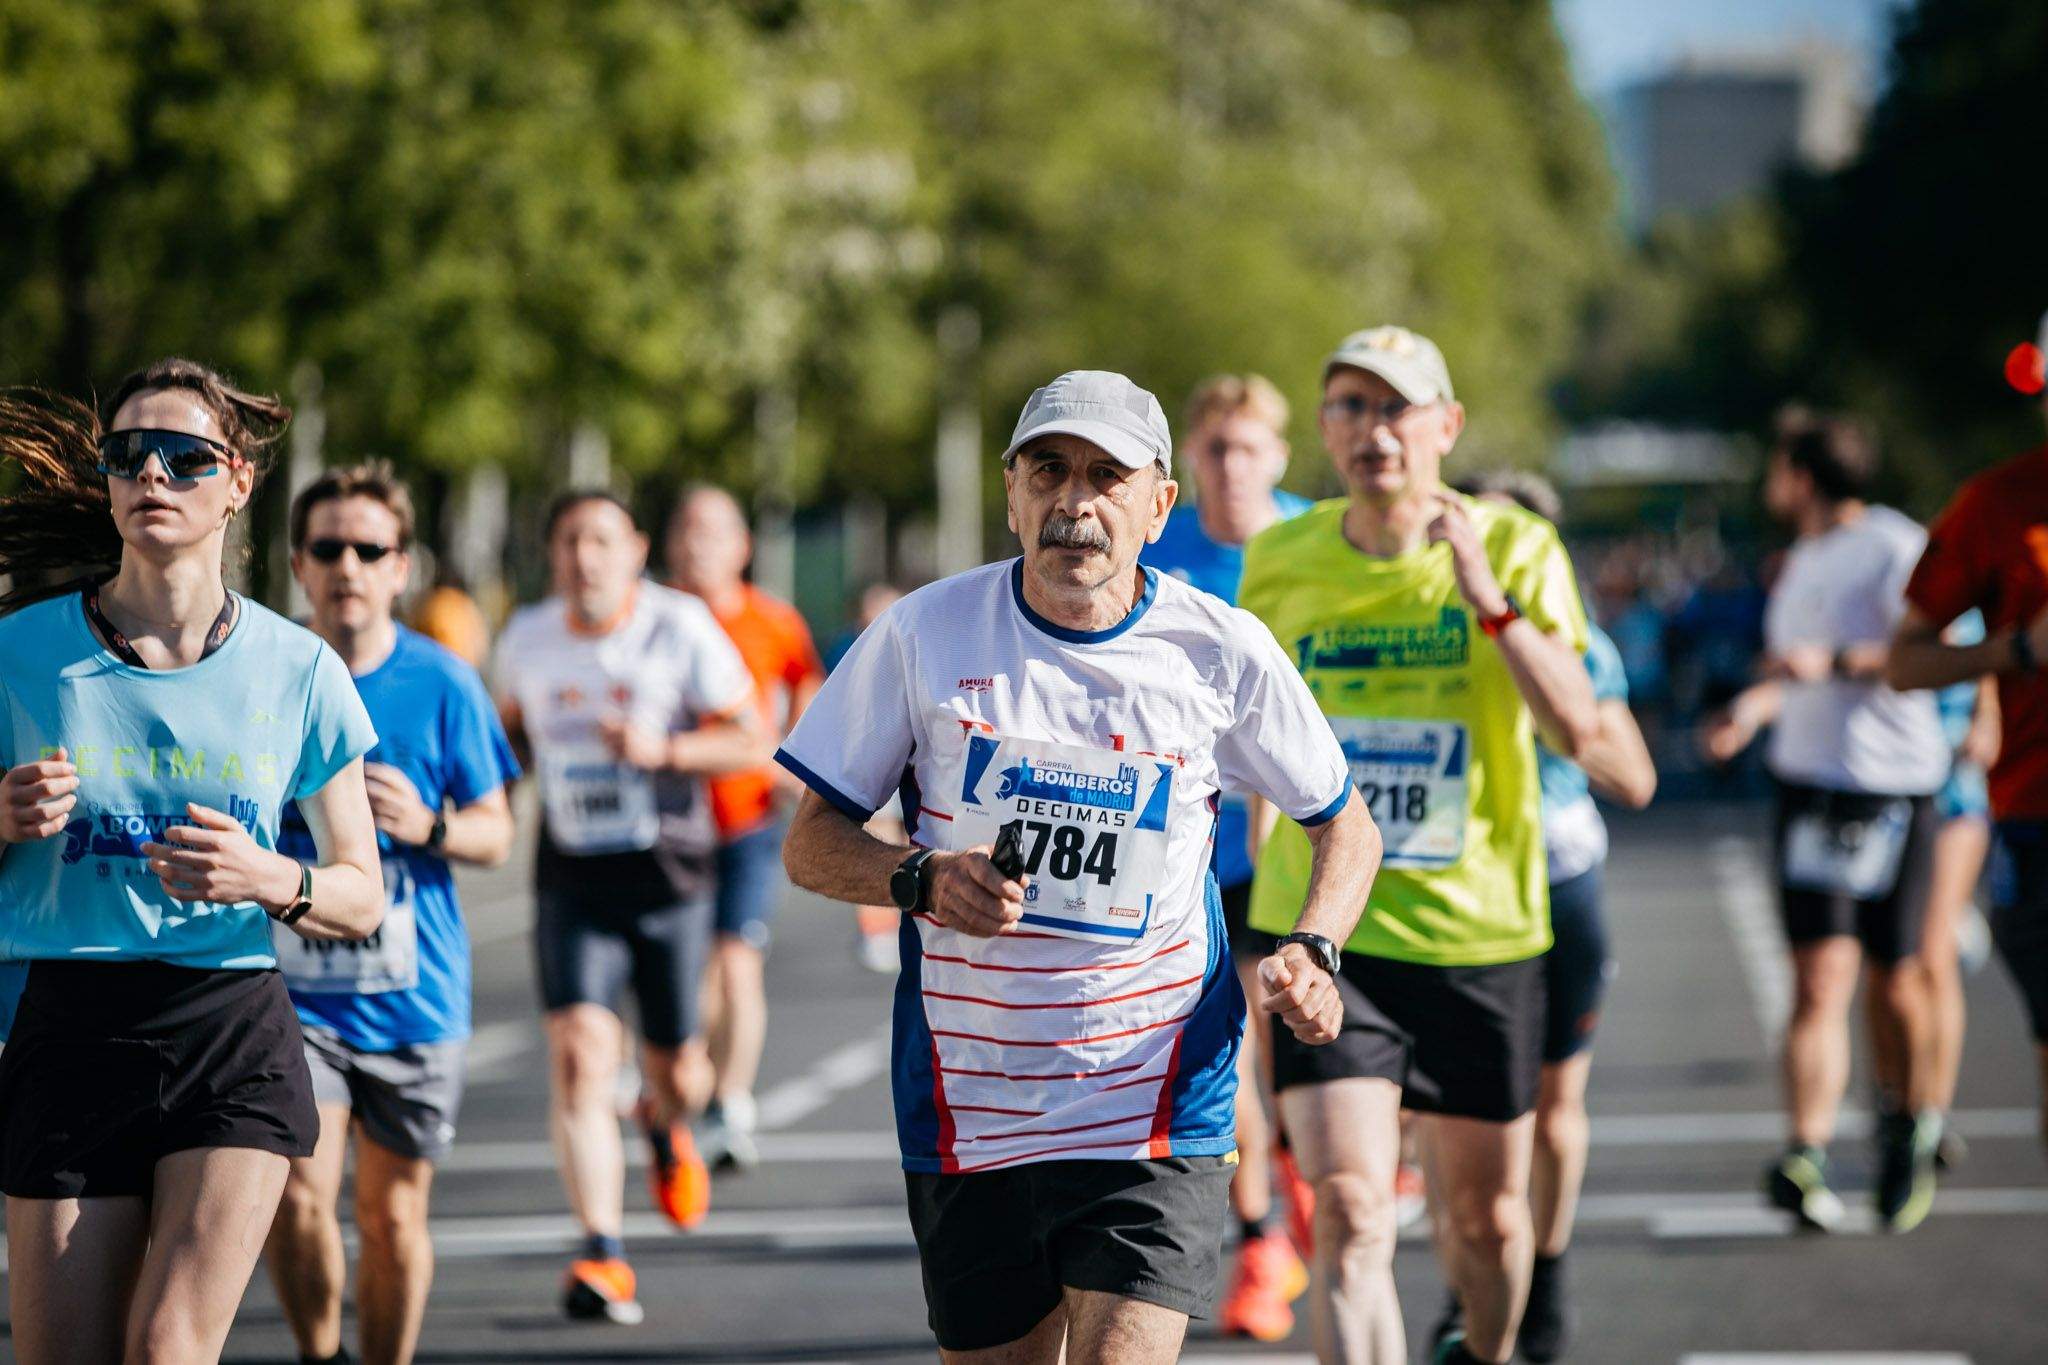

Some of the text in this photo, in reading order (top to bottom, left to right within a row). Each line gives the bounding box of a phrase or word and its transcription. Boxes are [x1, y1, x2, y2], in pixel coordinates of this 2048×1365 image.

[958, 678, 994, 689] AMURA
[1036, 759, 1073, 771] CARRERA
[1032, 769, 1134, 796] BOMBEROS
[1069, 788, 1134, 811] de MADRID
[1016, 798, 1127, 828] DECIMAS
